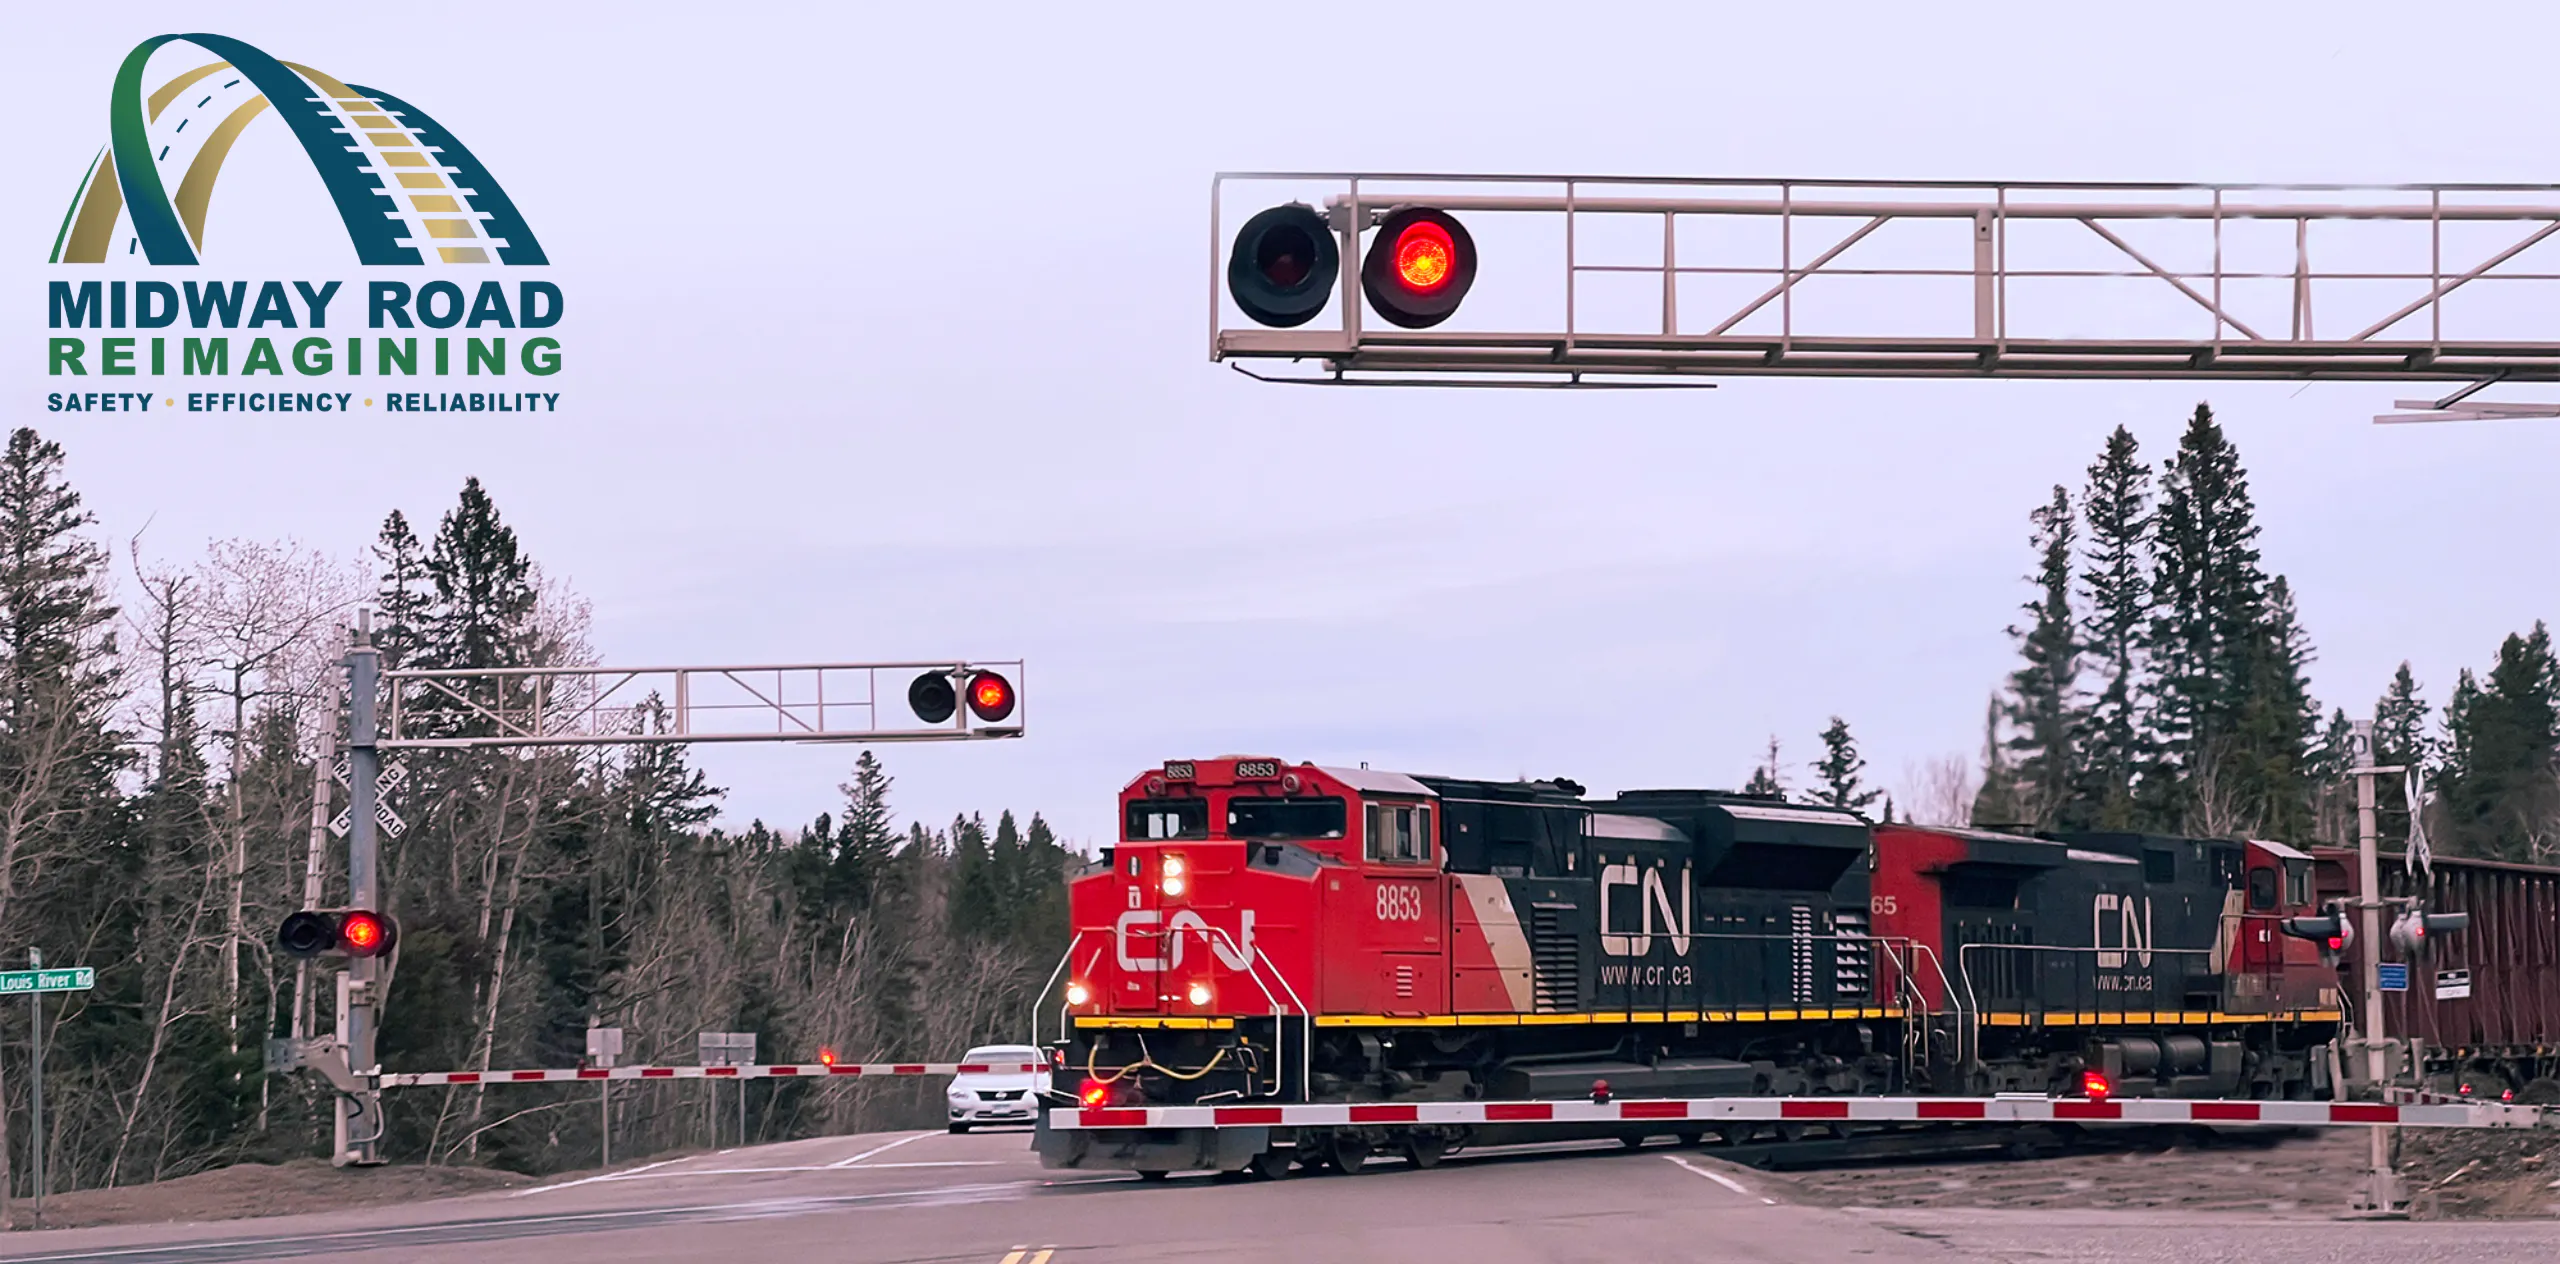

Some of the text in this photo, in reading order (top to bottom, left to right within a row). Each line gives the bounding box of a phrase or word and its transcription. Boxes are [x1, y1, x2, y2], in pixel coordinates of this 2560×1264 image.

[1167, 764, 1193, 779] 8853
[1238, 762, 1275, 777] 8853
[1376, 884, 1421, 921] 8853
[1601, 864, 1690, 957] CN
[1117, 909, 1255, 972] CN
[2093, 893, 2151, 968] CN
[1, 971, 93, 991] Louis River Rd
